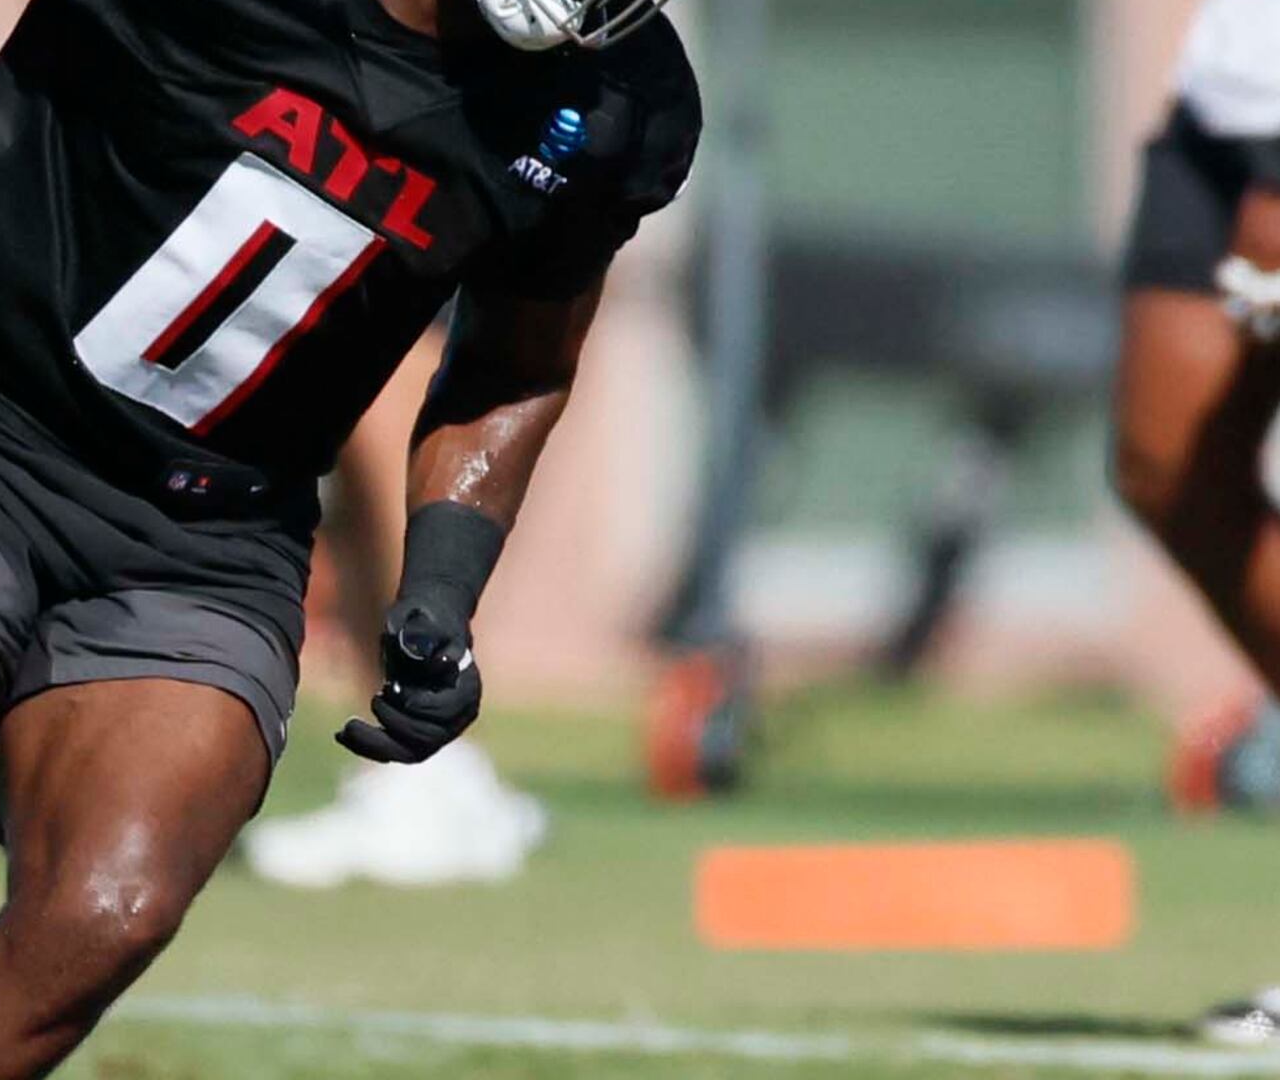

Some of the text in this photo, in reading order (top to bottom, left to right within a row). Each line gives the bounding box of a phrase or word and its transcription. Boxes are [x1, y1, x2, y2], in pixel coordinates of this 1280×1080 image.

[232, 86, 437, 250] ATL
[507, 155, 568, 194] AT&T
[74, 151, 386, 436] 0
